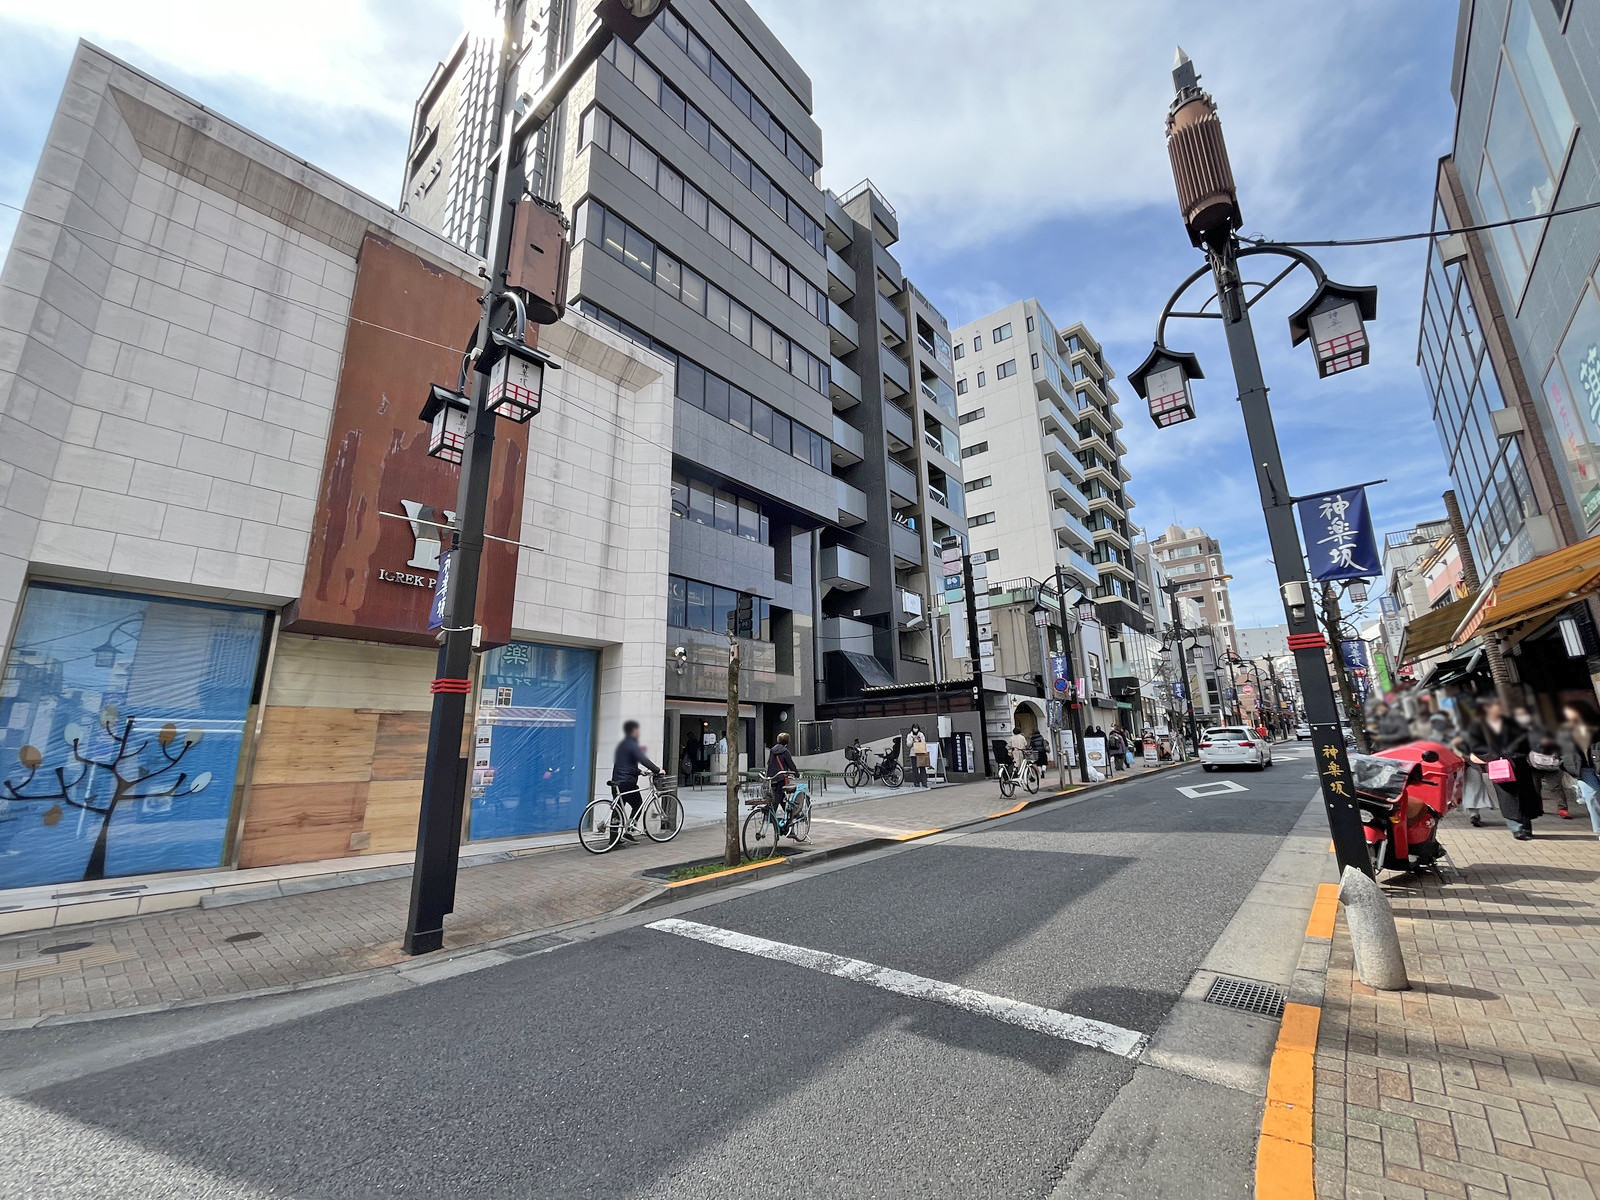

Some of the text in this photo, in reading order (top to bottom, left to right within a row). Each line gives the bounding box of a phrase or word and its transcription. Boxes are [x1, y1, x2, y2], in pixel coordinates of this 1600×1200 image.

[1317, 494, 1369, 571] 神楽坂
[379, 568, 425, 587] IGREK
[1322, 744, 1351, 798] 神楽坂
